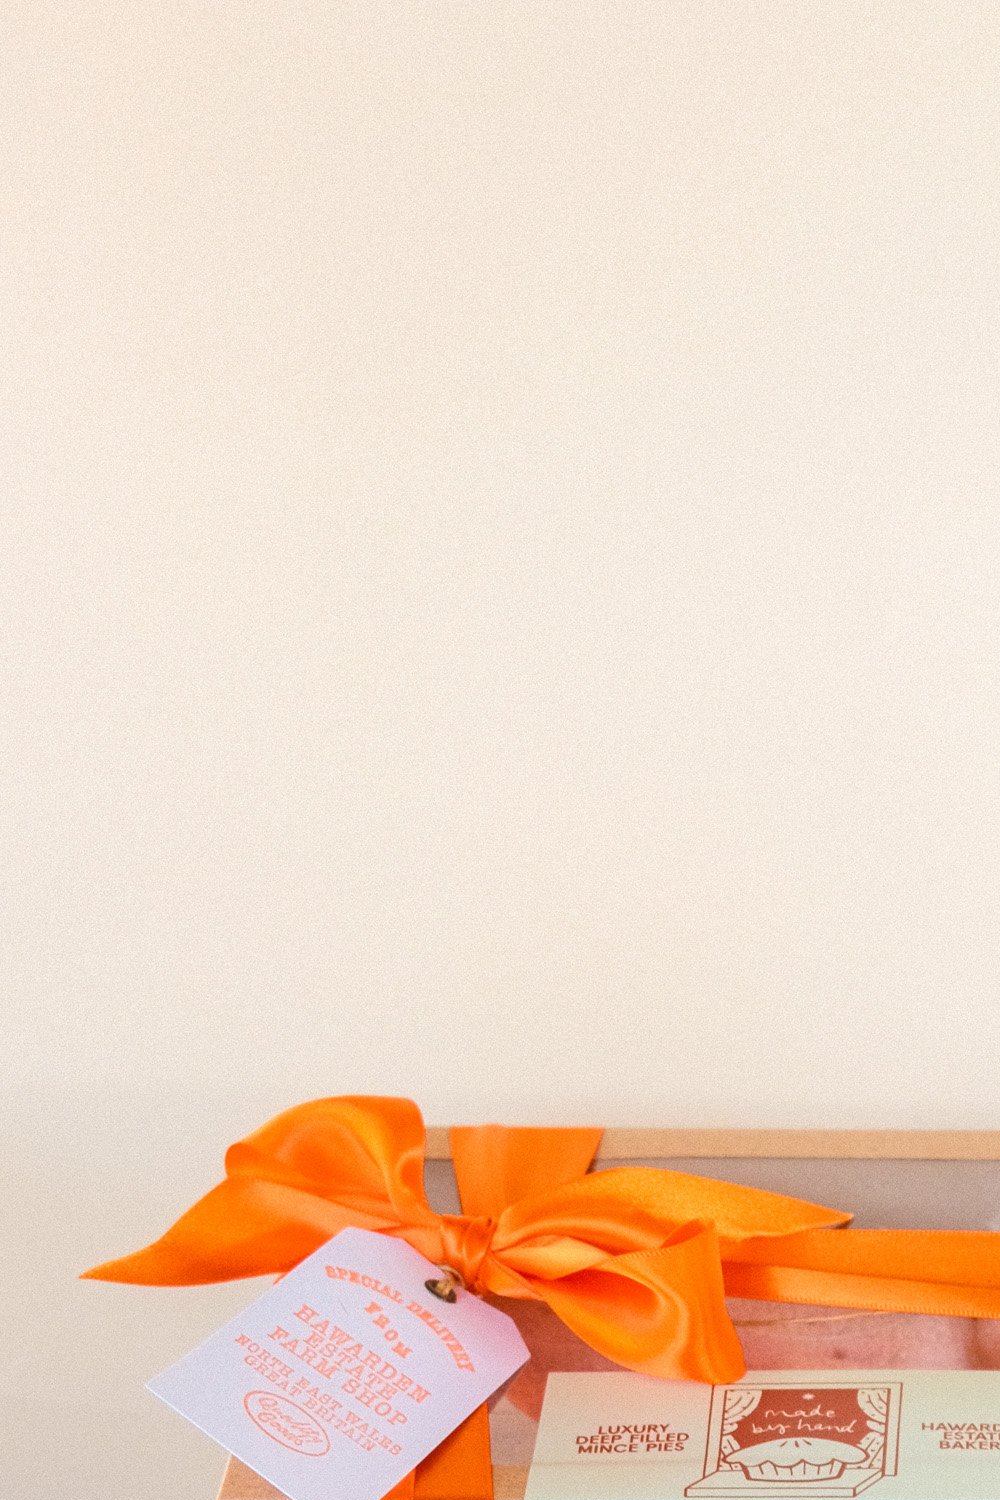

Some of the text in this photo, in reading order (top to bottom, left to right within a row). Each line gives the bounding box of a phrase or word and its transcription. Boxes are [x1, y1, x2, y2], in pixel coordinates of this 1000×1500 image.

[324, 1265, 476, 1373] SPECIAL DELIVERY
[364, 1301, 413, 1359] FROM
[267, 1325, 408, 1425] FARM SHOP
[293, 1303, 431, 1404] HAWARDEN
[304, 1331, 398, 1401] ESTATE
[234, 1333, 402, 1456] NORTH EAST WALES
[243, 1355, 375, 1452] GREAT BRITAIN
[765, 1404, 836, 1418] made
[576, 1433, 690, 1444] DEEP FILLED
[578, 1442, 684, 1454] MINCE PIES
[598, 1424, 670, 1434] LUXURY
[752, 1419, 857, 1435] by hand
